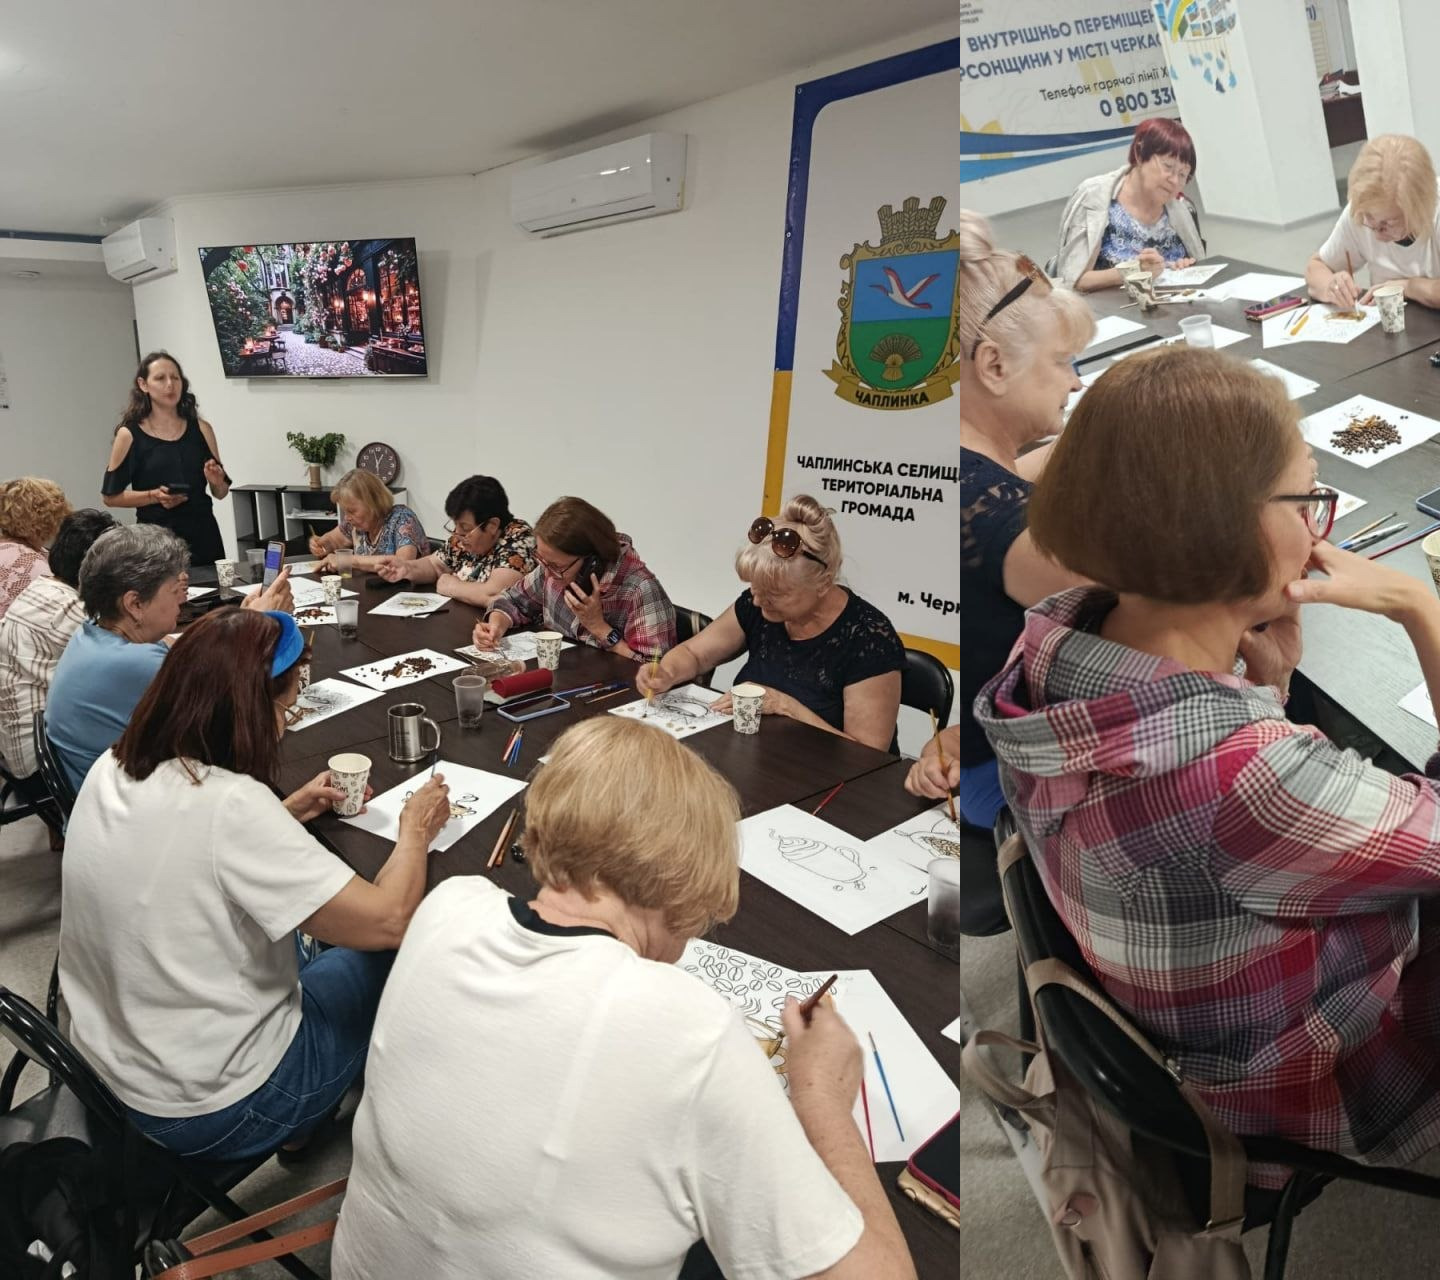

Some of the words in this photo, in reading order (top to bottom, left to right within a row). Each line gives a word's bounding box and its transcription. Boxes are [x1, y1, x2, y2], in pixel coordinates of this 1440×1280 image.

[966, 22, 1072, 53] ВНУТРІШНЬО
[1054, 47, 1063, 64] У
[1067, 41, 1110, 62] МІСТІ
[1039, 84, 1092, 101] Телефон
[1093, 73, 1136, 93] гарячої
[1138, 69, 1160, 83] лінії
[1100, 99, 1112, 117] 0
[1115, 91, 1149, 114] 800
[855, 390, 930, 408] ЧАПЛИНКА
[797, 455, 893, 475] ЧАПЛИНСЬКА
[897, 463, 960, 483] СЕЛИЩ
[822, 478, 944, 502] ТЕРИТОРІАЛЬНА
[841, 500, 915, 521] ГРОМАДА
[898, 591, 915, 605] м.
